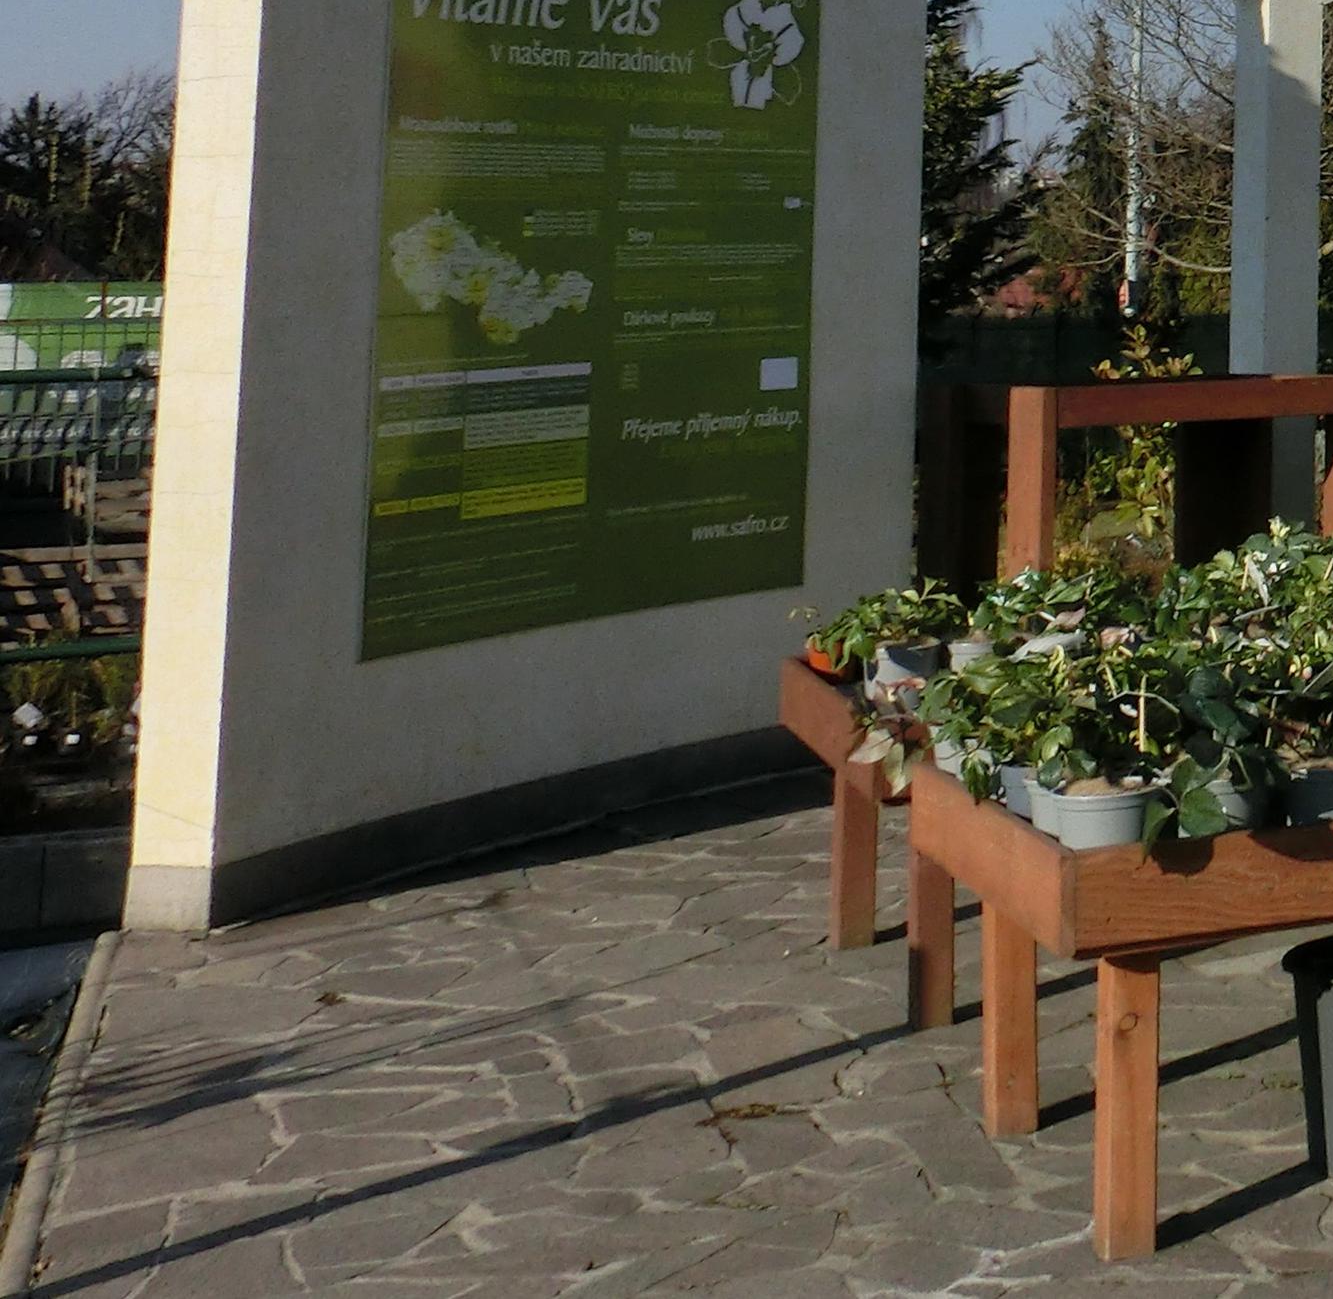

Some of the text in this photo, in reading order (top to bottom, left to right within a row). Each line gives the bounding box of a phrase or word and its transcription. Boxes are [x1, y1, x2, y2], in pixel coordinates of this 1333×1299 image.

[507, 39, 571, 69] našem
[576, 43, 696, 75] zahradnictví
[620, 417, 684, 444] Přejeme
[684, 408, 753, 441] příjemný
